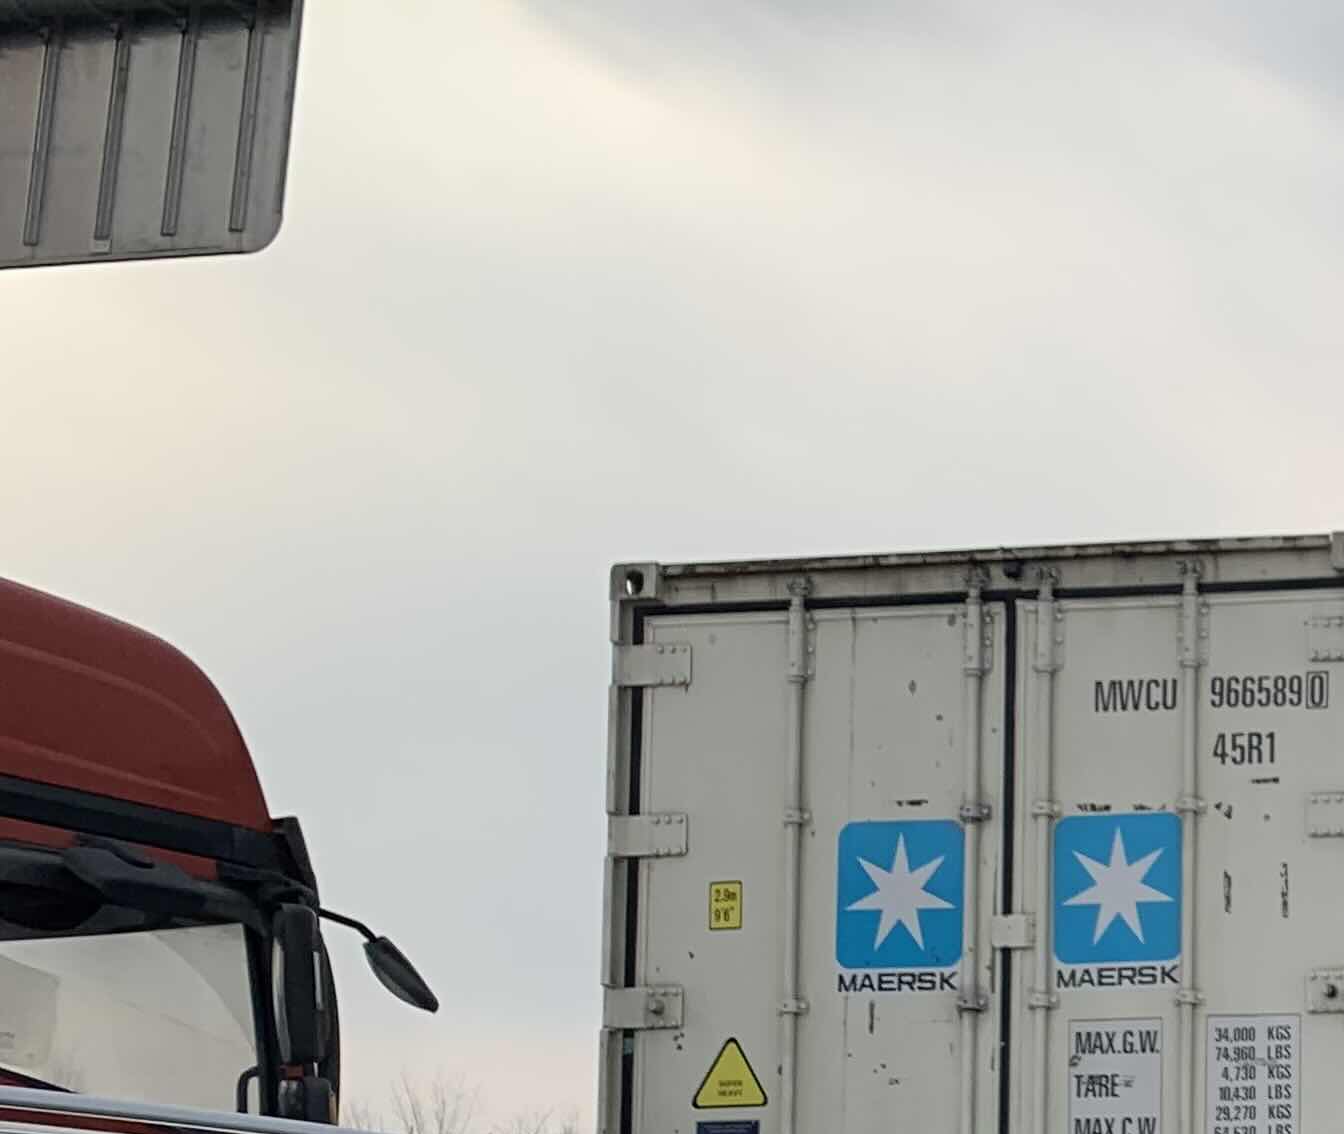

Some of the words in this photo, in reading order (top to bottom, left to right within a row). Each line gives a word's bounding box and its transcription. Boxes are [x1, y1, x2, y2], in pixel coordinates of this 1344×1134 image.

[1094, 678, 1178, 713] MWCU
[1212, 731, 1277, 766] 45R1
[837, 970, 960, 993] MAERSK
[1056, 963, 1180, 989] MAERSK
[1074, 1029, 1161, 1055] MAX.G.W.
[1267, 1025, 1291, 1041] KGS
[1267, 1045, 1291, 1060] LBS
[1267, 1065, 1291, 1080] KGS
[1074, 1074, 1121, 1099] TARE
[1267, 1084, 1292, 1099] LBS
[1267, 1104, 1292, 1120] KGS
